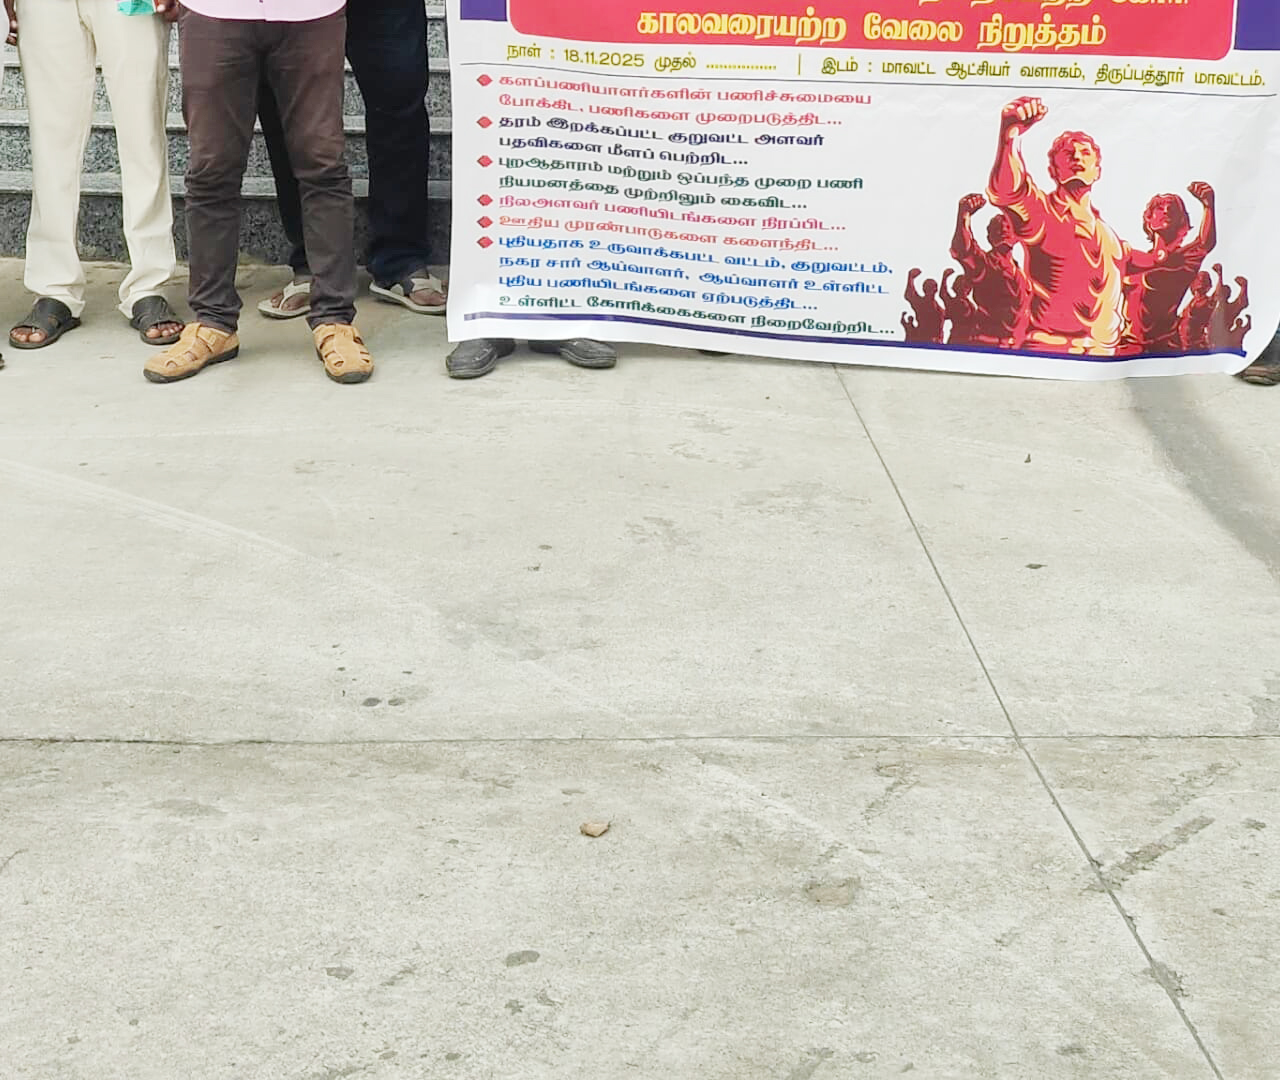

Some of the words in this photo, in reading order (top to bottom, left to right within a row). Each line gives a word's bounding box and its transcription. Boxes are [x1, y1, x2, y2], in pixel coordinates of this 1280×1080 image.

[637, 6, 846, 46] காலவரையற்ற
[863, 15, 962, 41] வேலை
[977, 13, 1106, 51] நிறுத்தம்
[507, 43, 541, 60] நாள்
[564, 48, 644, 67] 18.11.2025
[654, 52, 696, 72] முதல்
[821, 56, 858, 74] இடம்
[882, 61, 935, 74] மாவட்ட
[945, 61, 1010, 80] ஆட்சியர்
[1020, 62, 1085, 81] வளாகம்,
[1195, 70, 1265, 86] மாவட்டம்.
[499, 75, 712, 101] களப்பணியாளர்களின்
[717, 90, 872, 104] பணிச்சுமையை
[588, 104, 690, 121] பணிகளை
[499, 116, 541, 129] தரம்
[546, 117, 664, 140] இறக்கப்பட்ட
[668, 131, 749, 146] குறுவட்ட
[754, 134, 824, 146] அளவர்
[499, 136, 602, 153] பதவிகளை
[608, 143, 654, 160] மீளப்
[498, 157, 603, 172] புறஆதாரம்
[608, 165, 672, 182] மற்றும்
[677, 172, 749, 187] ஒப்பந்த
[755, 176, 811, 190] முறை
[817, 178, 863, 190] பணி
[498, 175, 619, 195] நியமனத்தை
[624, 187, 716, 206] முற்றிலும்
[499, 195, 599, 211] நிலஅளவர்
[604, 202, 757, 228] பணியிடங்களை
[498, 235, 584, 250] புதியதாக
[499, 215, 559, 230] ஊதிய
[564, 220, 718, 244] முரண்பாடுகளை
[498, 274, 542, 288] புதிய
[547, 277, 695, 299] பணியிடங்களை
[499, 256, 541, 269] நகர
[546, 256, 581, 269] சார்
[699, 271, 799, 290] ஆய்வாளர்
[804, 279, 889, 294] உள்ளிட்ட
[499, 294, 582, 308] உள்ளிட்ட
[586, 296, 745, 324] கோரிக்கைகளை
